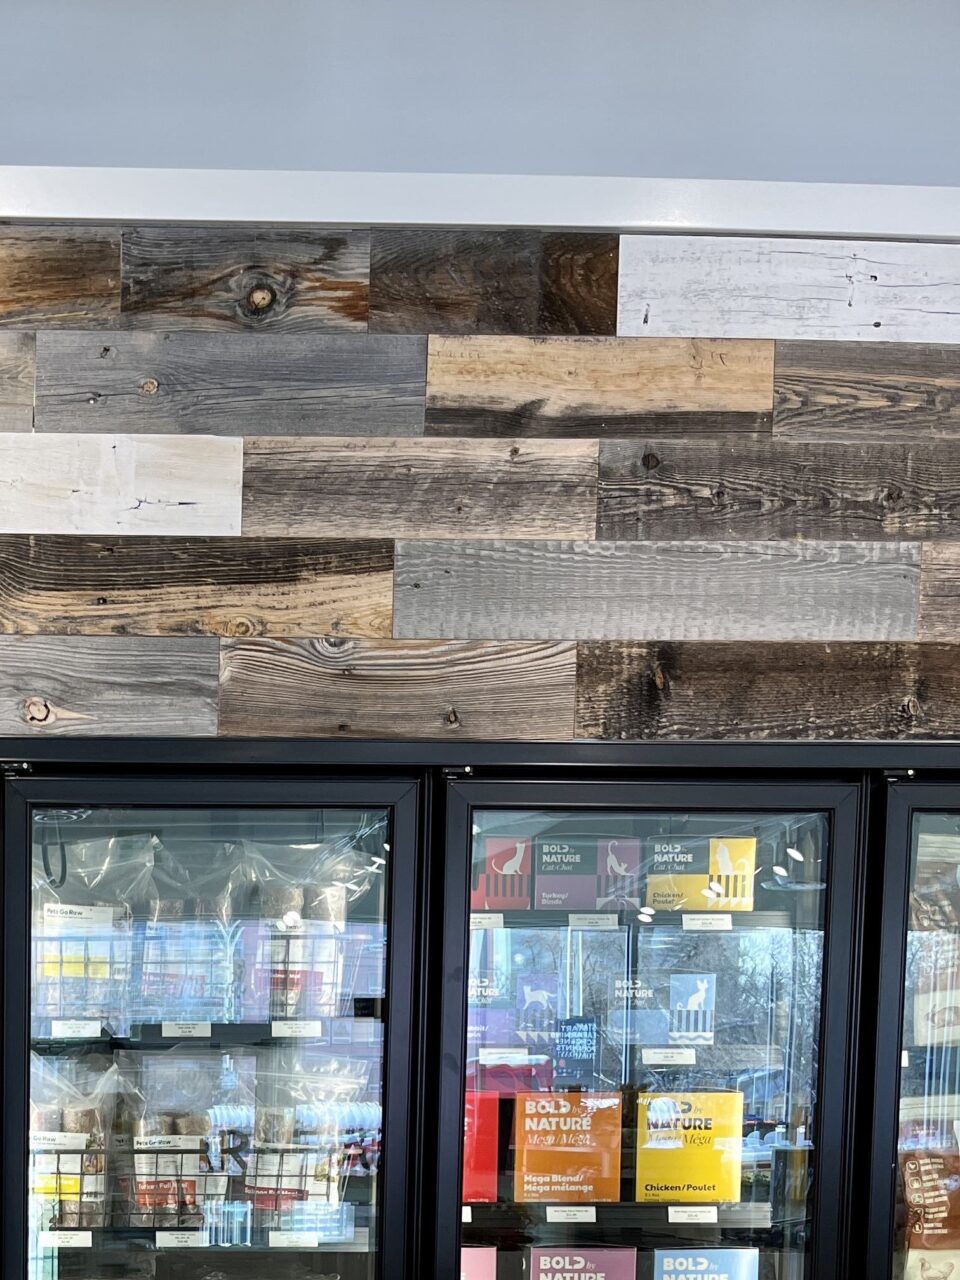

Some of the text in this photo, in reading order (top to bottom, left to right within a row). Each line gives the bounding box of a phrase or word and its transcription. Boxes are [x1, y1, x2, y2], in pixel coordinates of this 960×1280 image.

[542, 844, 569, 853] BOLD
[654, 844, 681, 853] BOLD
[542, 854, 581, 863] NATURE
[654, 854, 693, 863] NATURE
[652, 892, 683, 900] Chicken/
[615, 989, 653, 998] NATURE
[525, 1101, 570, 1114] BOLD
[524, 1118, 591, 1130] NATURE
[524, 1173, 583, 1184] Mega Blend/
[524, 1183, 593, 1193] Méga mélange
[540, 1257, 585, 1269] BOLD
[663, 1258, 707, 1270] BOLD
